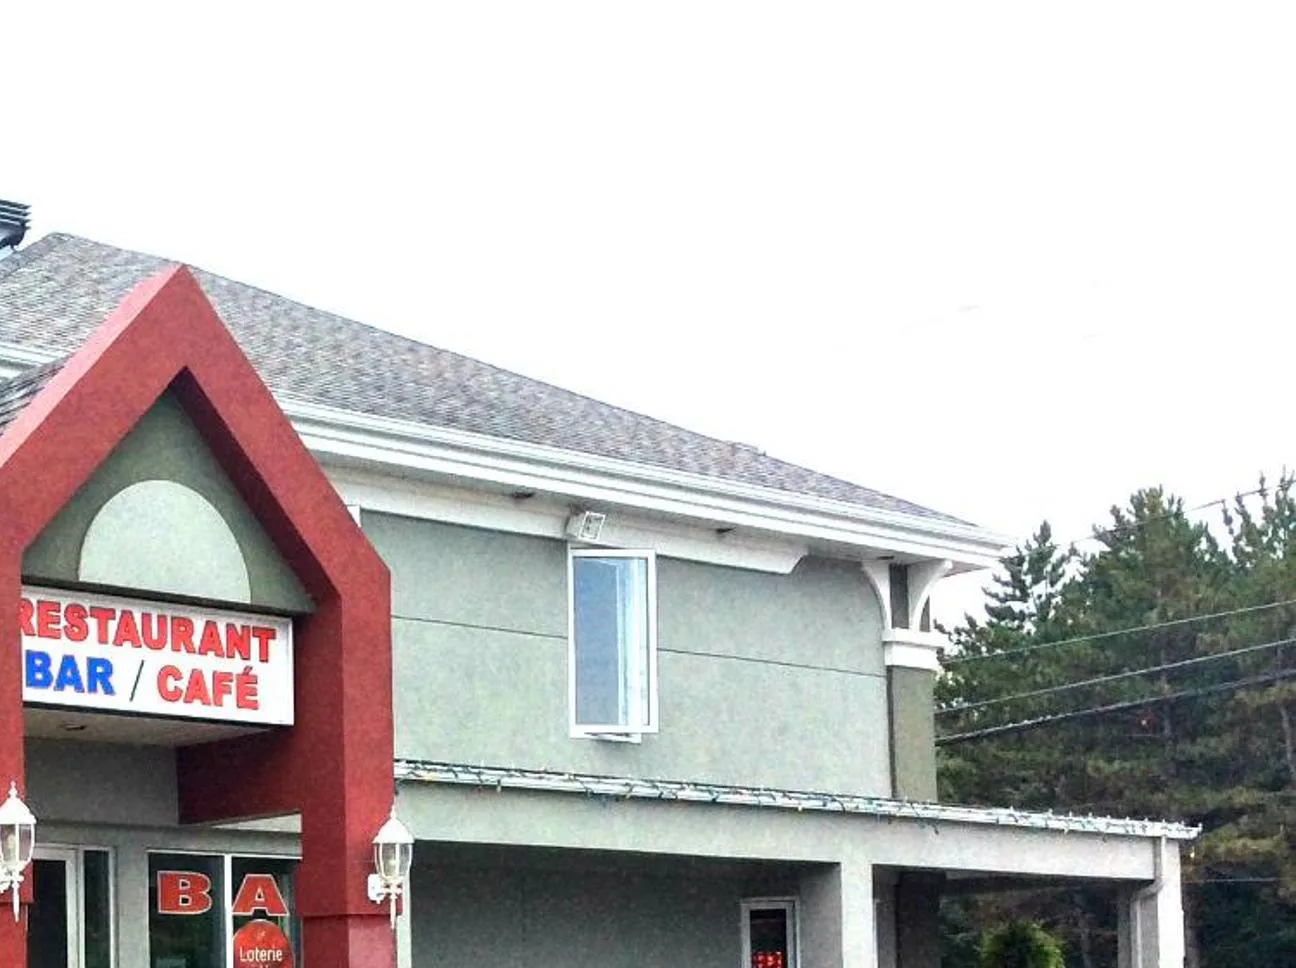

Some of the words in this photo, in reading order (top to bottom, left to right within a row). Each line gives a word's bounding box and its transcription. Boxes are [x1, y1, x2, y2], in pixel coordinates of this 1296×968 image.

[16, 597, 278, 663] RESTAURANT
[24, 648, 116, 697] BAR
[156, 664, 260, 711] CAFÉ
[238, 945, 284, 963] Loterie
